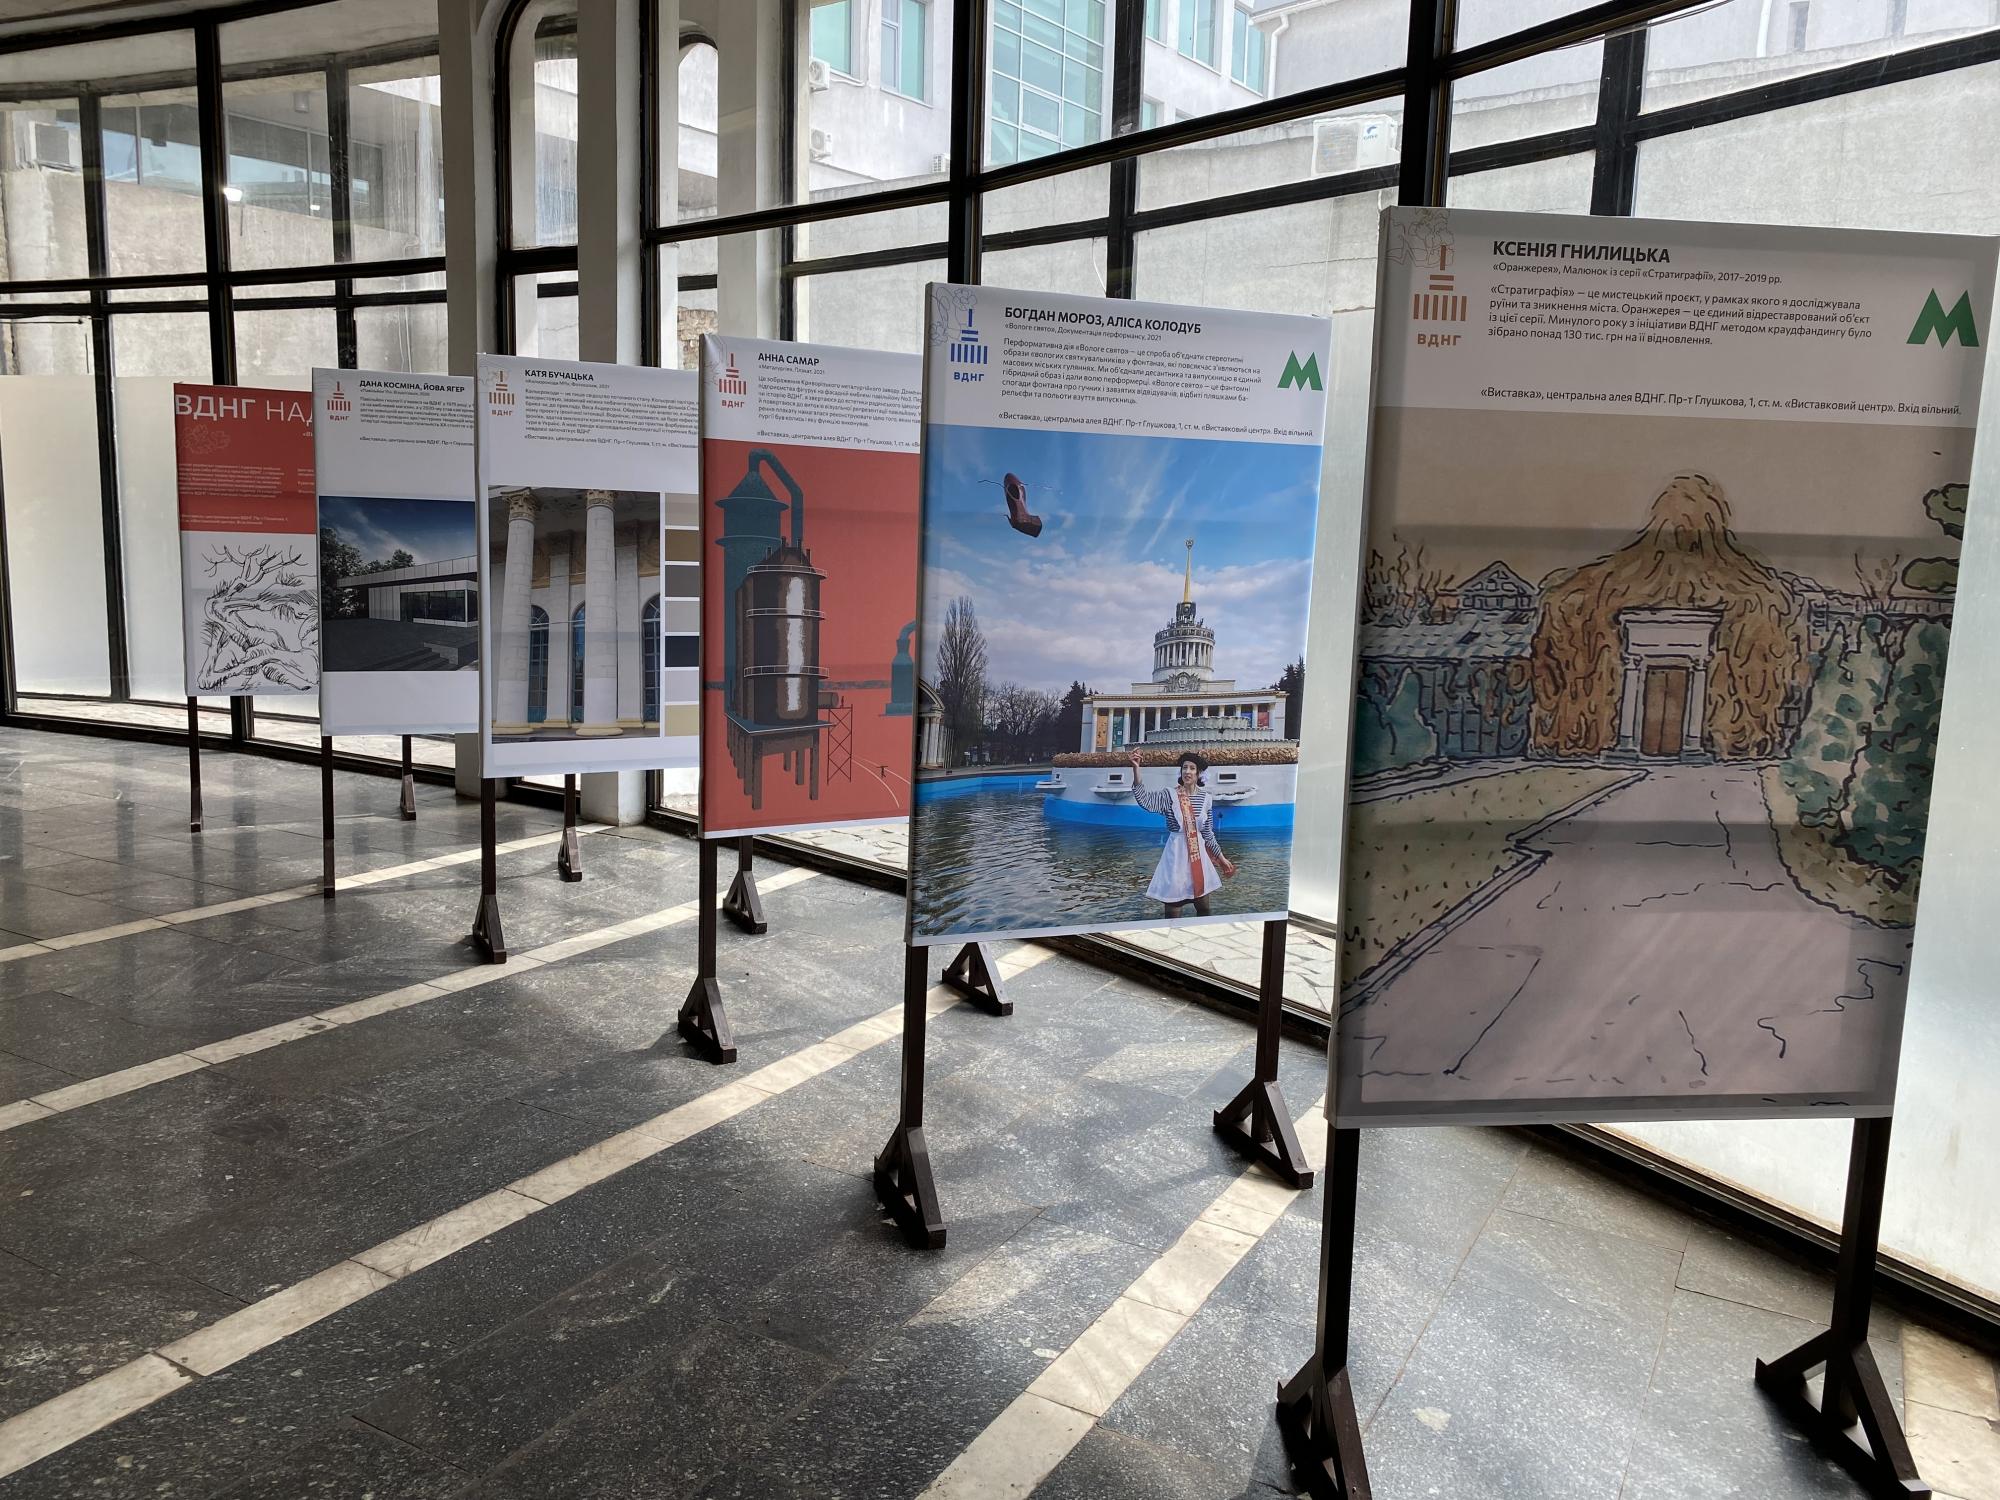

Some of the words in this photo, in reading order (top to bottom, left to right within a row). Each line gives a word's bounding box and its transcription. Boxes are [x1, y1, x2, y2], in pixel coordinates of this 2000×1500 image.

[1493, 241, 1556, 257] КСЕНІЯ
[1560, 244, 1670, 262] ГНИЛИЦЬКА
[1492, 262, 1560, 274] «Оранжерея»,
[1562, 265, 1607, 275] Малюнок
[1610, 267, 1617, 276] із
[1619, 268, 1641, 278] серії
[1642, 269, 1715, 280] «Стратиграфії»,
[1768, 276, 1781, 284] рр.
[1490, 284, 1574, 297] «Стратиграфія»
[1587, 290, 1599, 299] це
[1601, 291, 1662, 300] мистецький
[1664, 294, 1701, 303] проєкт,
[1789, 299, 1860, 309] досліджувала
[1489, 298, 1518, 310] руїни
[1533, 302, 1587, 311] зникнення
[1589, 302, 1618, 312] міста.
[1621, 303, 1680, 316] Оранжерея
[1693, 309, 1705, 318] це
[1707, 309, 1743, 318] єдиний
[1746, 310, 1837, 321] відреставрований
[1005, 307, 1055, 322] БОГДАН
[1057, 312, 1104, 327] МОРОЗ,
[1106, 316, 1142, 328] АЛІСА
[1144, 319, 1200, 333] КОЛОДУБ
[1488, 312, 1497, 322] із
[1499, 312, 1518, 324] цієї
[1519, 314, 1545, 325] серії.
[1548, 314, 1600, 326] Минулого
[1602, 319, 1627, 328] року
[1636, 318, 1686, 329] ініціативи
[1688, 320, 1718, 331] ВДНГ
[1720, 324, 1765, 333] методом
[1767, 326, 1846, 337] краудфандингу
[1848, 327, 1871, 338] було
[1057, 326, 1101, 336] Документація
[1417, 333, 1461, 347] ВДНГ
[1488, 326, 1528, 337] зібрано
[1530, 330, 1561, 339] понад
[1564, 329, 1582, 339] 130
[1605, 333, 1622, 342] грн
[1639, 332, 1645, 341] її
[1647, 333, 1712, 344] відновлення.
[1003, 337, 1062, 349] Перформативна
[1075, 343, 1104, 352] «Вологе
[757, 352, 784, 362] АННА
[786, 355, 819, 365] САМАР
[1003, 348, 1029, 356] образи
[1131, 358, 1166, 367] фонтанах,
[1034, 361, 1061, 369] міських
[524, 369, 546, 378] КАТЯ
[548, 371, 593, 381] БУЧАЦЬКА
[954, 372, 984, 382] ВДНГ
[1002, 368, 1038, 377] гібридний
[1039, 371, 1061, 379] образ
[1103, 377, 1150, 385] перформерці.
[1151, 379, 1179, 387] «Вологе
[1219, 384, 1250, 392] фантомні
[382, 382, 422, 391] КОСМІНА,
[423, 382, 445, 391] ЙОВА
[1031, 380, 1062, 389] фонтана
[175, 394, 256, 421] ВДНГ
[722, 400, 744, 408] ВДНГ
[1480, 386, 1544, 398] «Виставка»,
[1546, 392, 1606, 401] центральна
[1634, 392, 1666, 403] ВДНГ.
[1668, 393, 1693, 405] Пр-т
[1694, 394, 1746, 407] Глушкова,
[1749, 397, 1755, 408] 1,
[1784, 398, 1856, 409] «Виставковий
[1858, 403, 1895, 413] центр».
[1897, 402, 1919, 413] Вхід
[1921, 404, 1961, 414] вільний.
[998, 411, 1042, 421] «Виставка»,
[1102, 417, 1124, 426] ВДНГ.
[1125, 418, 1141, 427] Пр-т
[1142, 420, 1177, 429] Глушкова,
[1201, 423, 1247, 432] «Виставковий
